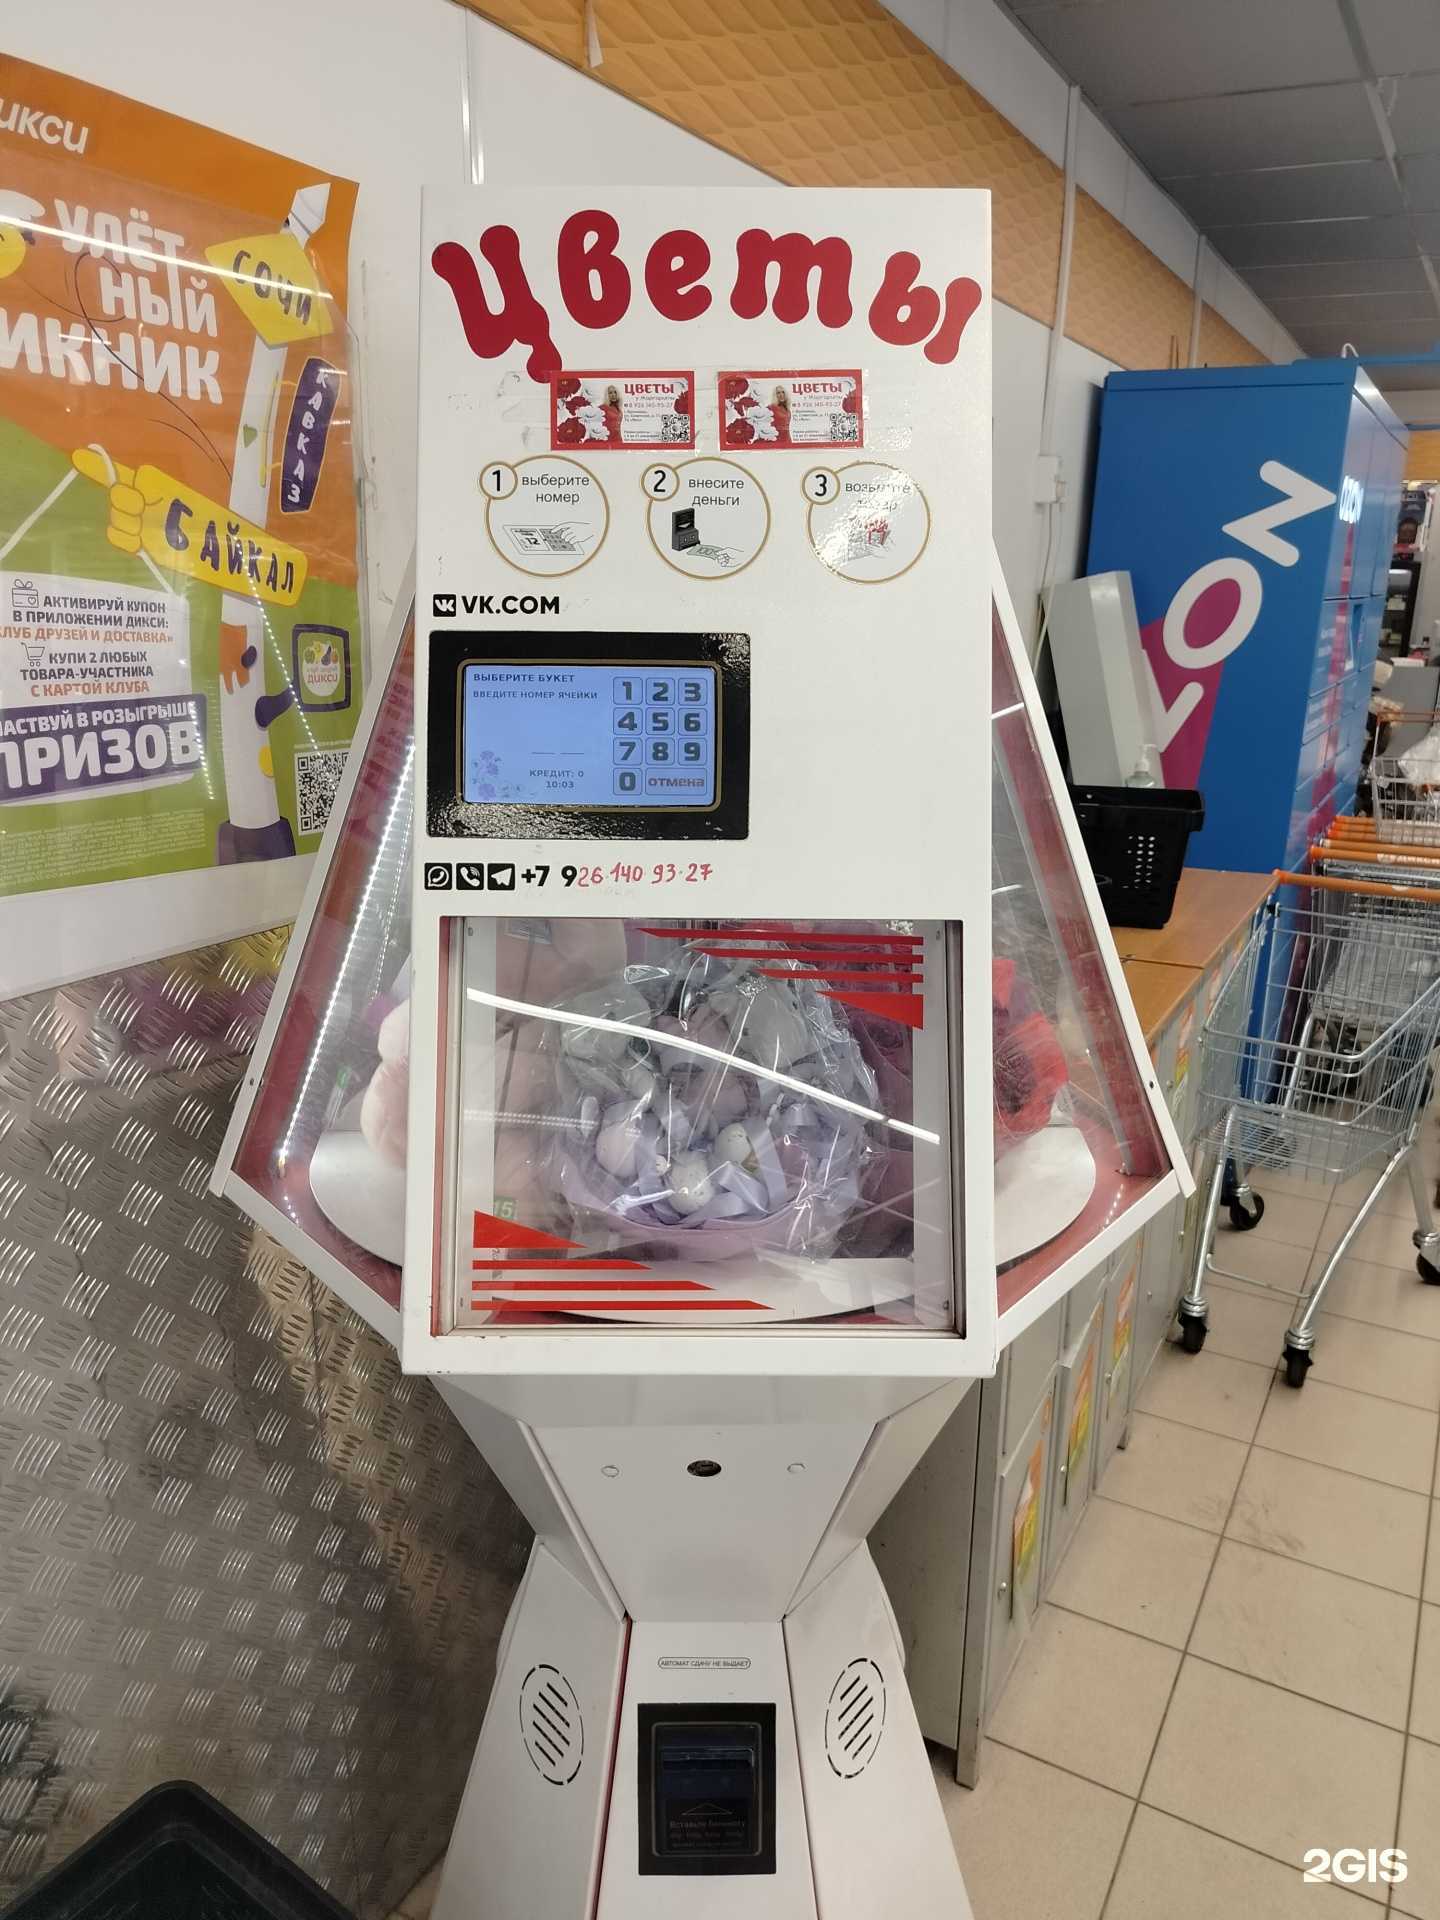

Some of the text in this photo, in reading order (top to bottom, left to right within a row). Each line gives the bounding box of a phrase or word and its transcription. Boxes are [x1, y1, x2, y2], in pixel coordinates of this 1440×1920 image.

[54, 198, 184, 329] УЛЁТ
[233, 250, 312, 325] СОЧИ
[100, 267, 218, 337] НЫЙ
[624, 383, 674, 396] ЦВЕТЫ
[792, 383, 842, 395] ЦВЕТЫ
[288, 369, 329, 503] КАВКАЗ
[491, 469, 590, 492] 1 выберите
[653, 469, 744, 493] 2 внесите
[815, 473, 827, 497] 3
[535, 493, 580, 505] номер
[691, 495, 740, 506] деньги
[165, 498, 294, 593] БАЙКАЛ
[43, 595, 166, 614] АКТИВИРУЙ КУПОН
[461, 595, 560, 615] VK.COM
[13, 610, 169, 629] В ПРИЛОЖЕНИИ ДИКСИ:
[34, 627, 88, 641] ДРУЗЕЙ
[91, 630, 100, 641] И
[49, 651, 147, 665] КУПИ 2 ЛЮБЫХ
[20, 666, 154, 680] ТОВАРА-УЧАСТНИКА
[473, 673, 575, 683] ВЫБЕРИТЕ БУКЕТ
[31, 681, 150, 697] С КАРТОЙ КЛУБА
[473, 690, 518, 699] ВВЕДИТЕ
[520, 691, 555, 699] НОМЕР
[622, 681, 702, 702] 1 2 3
[77, 712, 89, 728] В
[617, 711, 701, 732] 4 5 6
[619, 741, 701, 761] 7 8 9
[529, 769, 584, 778] КРЕДИТ: 0
[619, 771, 636, 791] 0
[545, 781, 575, 789] 10:03
[521, 865, 551, 887] +7
[610, 862, 643, 883] 140
